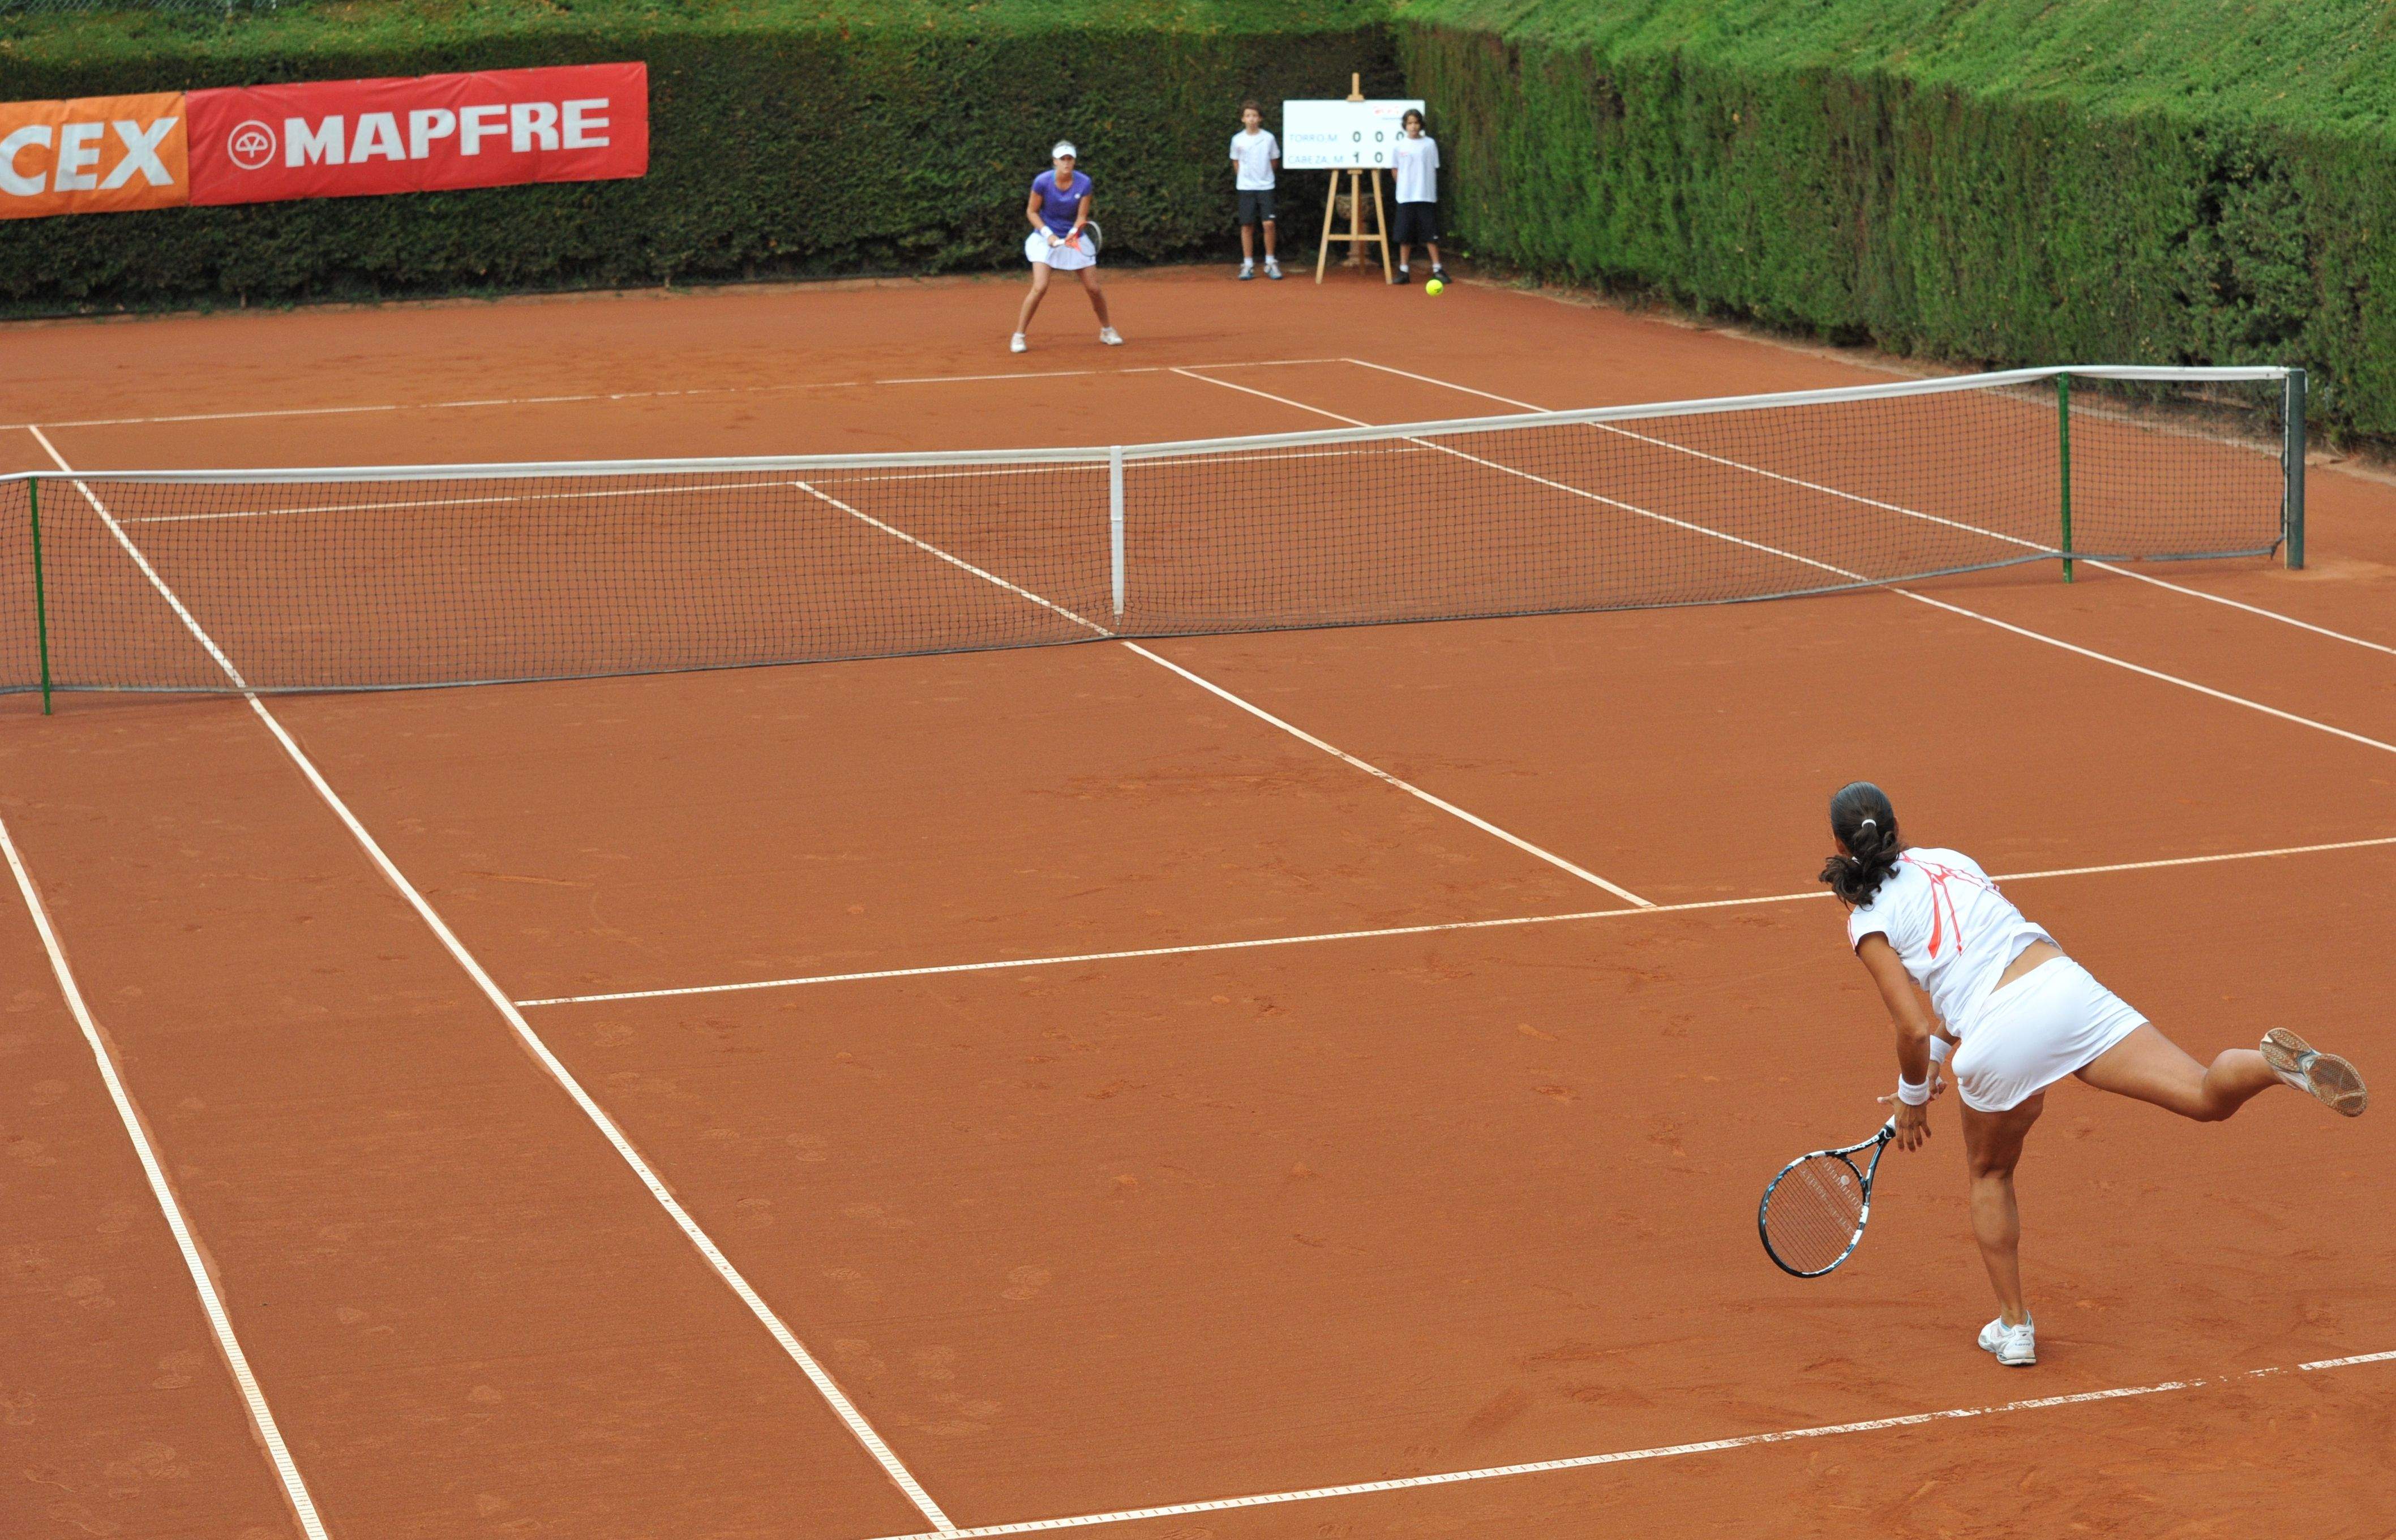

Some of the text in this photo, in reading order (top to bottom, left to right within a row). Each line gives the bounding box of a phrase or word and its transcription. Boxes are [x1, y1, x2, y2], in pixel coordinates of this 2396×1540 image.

[285, 98, 610, 168] MAPFRE
[1353, 131, 1361, 142] 0
[1375, 131, 1384, 142] 0
[0, 117, 179, 196] CEX
[1353, 152, 1360, 163] 1
[1374, 152, 1383, 163] 0
